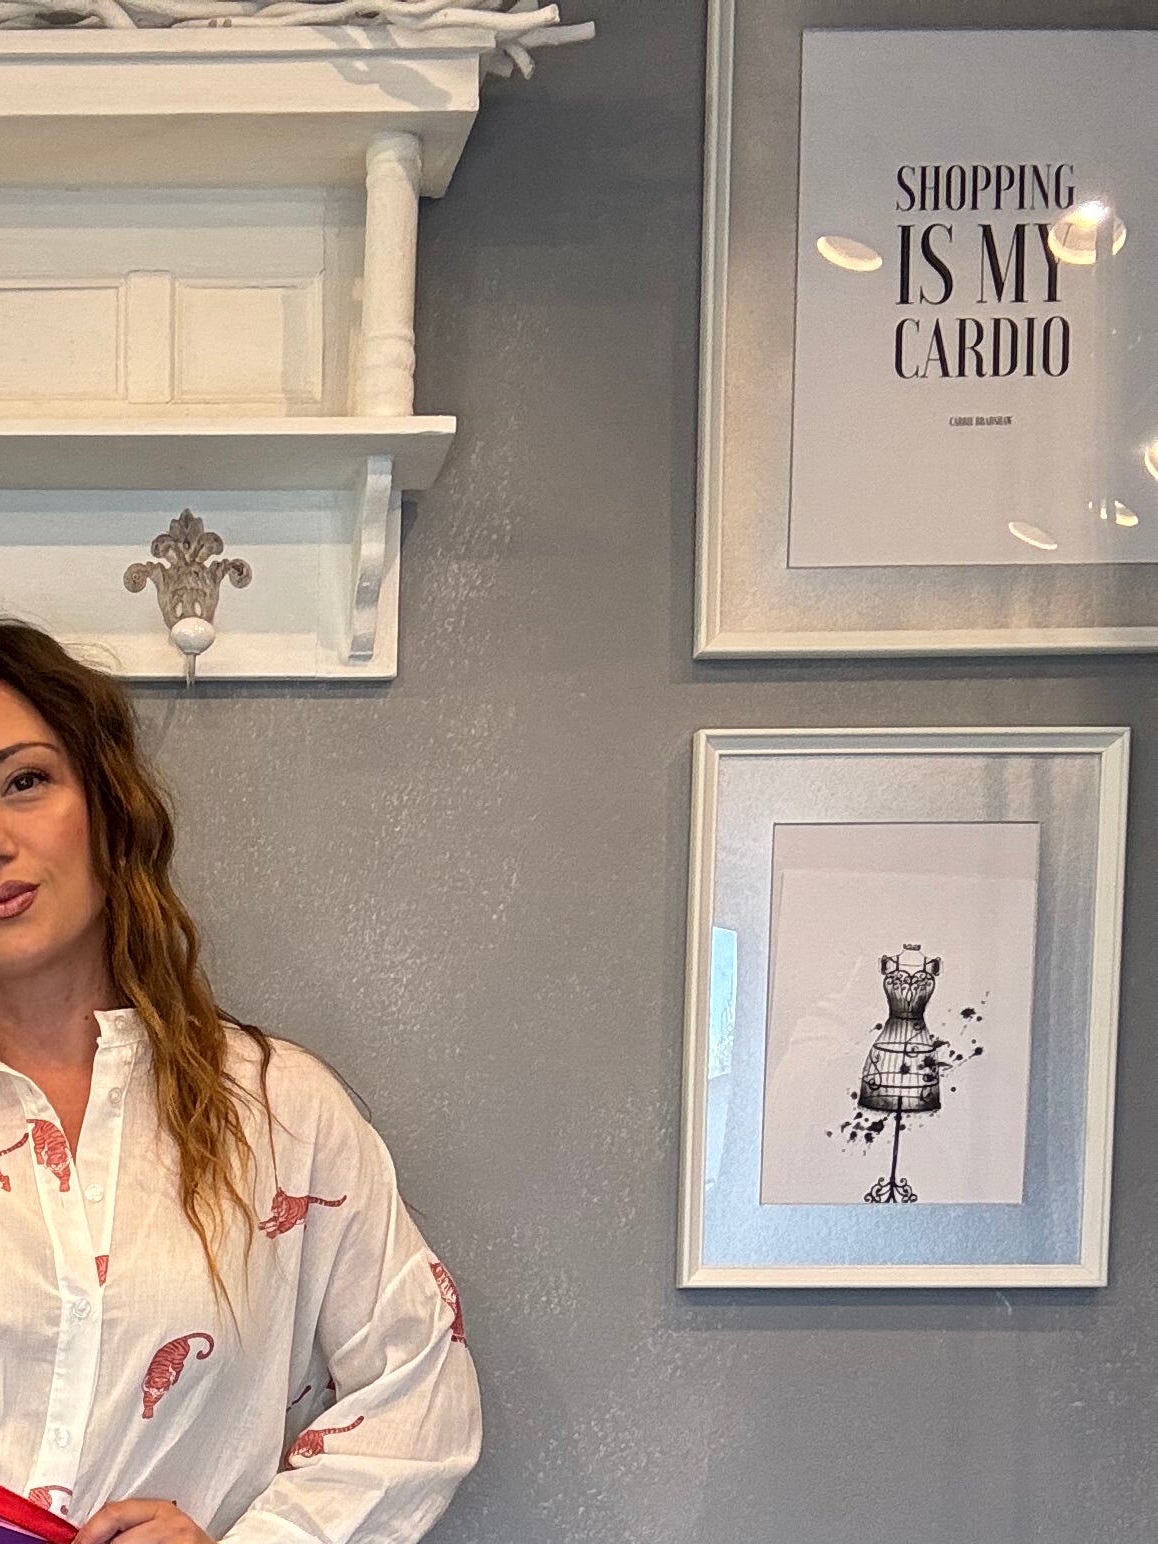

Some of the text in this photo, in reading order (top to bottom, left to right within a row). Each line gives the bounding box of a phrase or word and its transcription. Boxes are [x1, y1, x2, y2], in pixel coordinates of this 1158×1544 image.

[895, 163, 1075, 211] SHOPPING
[895, 222, 1074, 305] IS MY
[894, 315, 1070, 379] CARDIO
